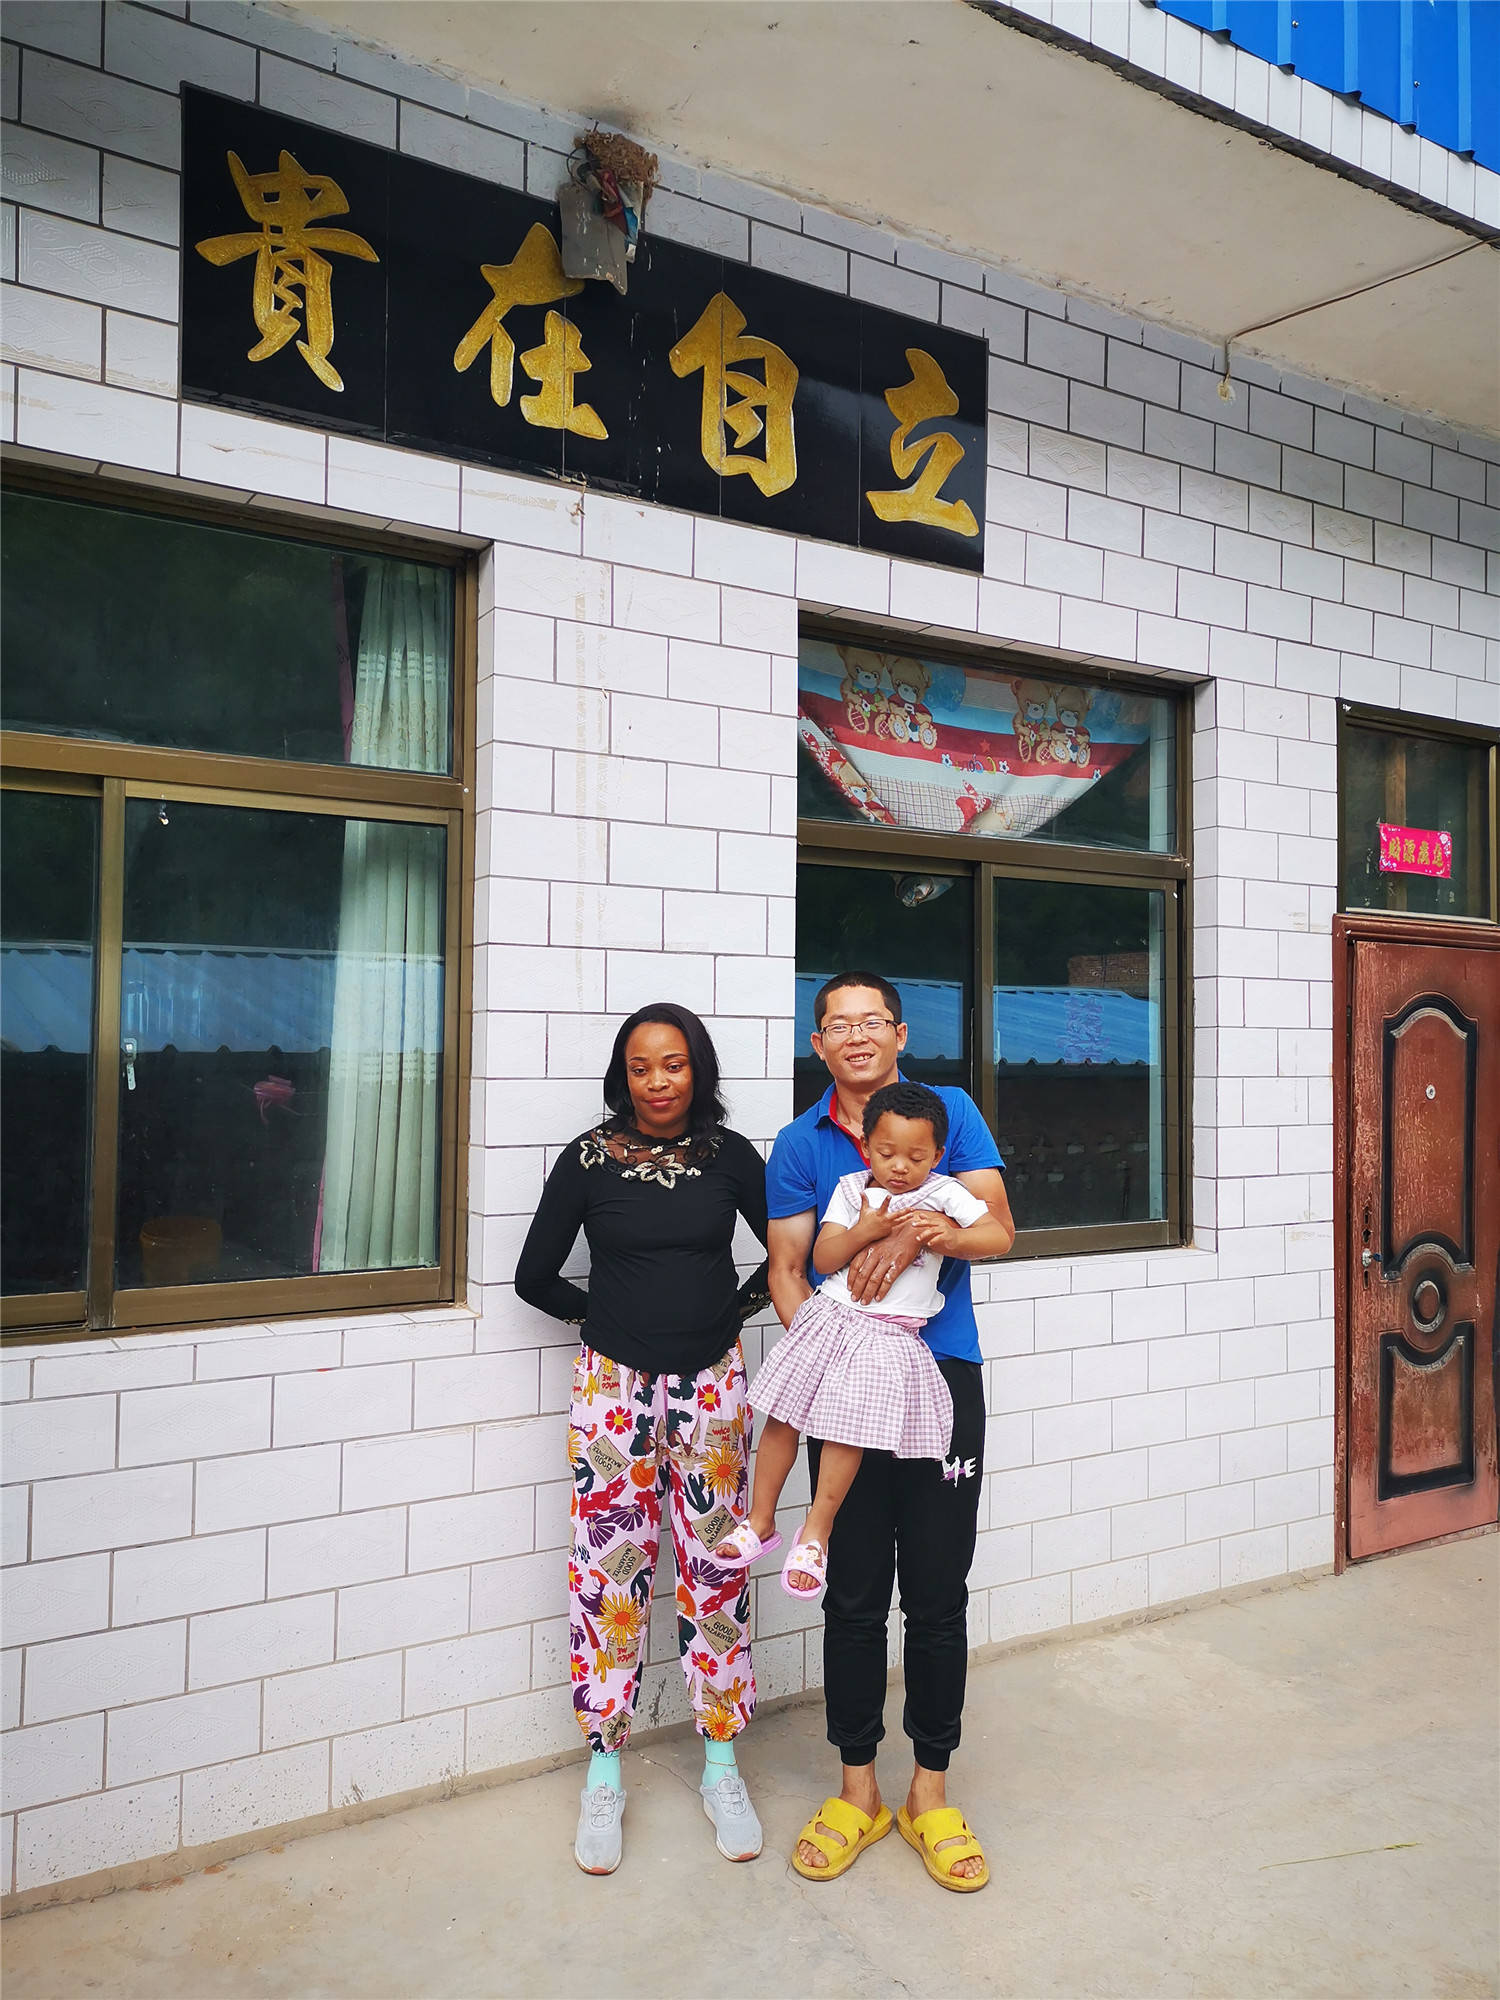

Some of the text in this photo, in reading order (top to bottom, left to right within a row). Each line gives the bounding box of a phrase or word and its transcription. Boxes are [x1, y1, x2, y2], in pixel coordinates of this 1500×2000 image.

[595, 1454, 612, 1471] GOOD
[704, 1515, 720, 1534] GOOD
[622, 1556, 637, 1575] GOOD
[713, 1621, 734, 1636] GOOD
